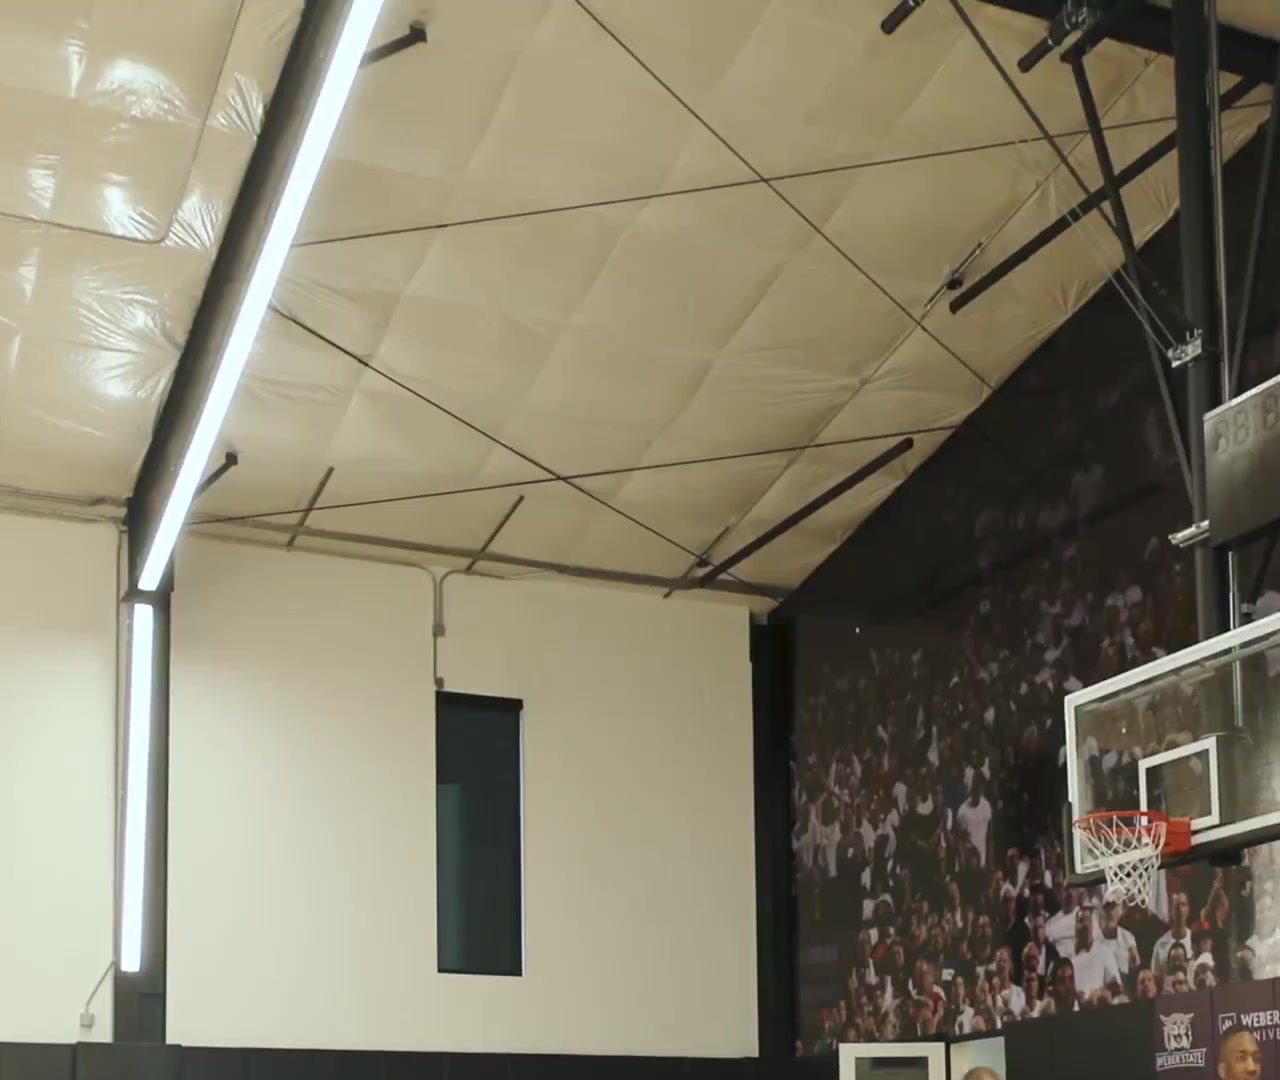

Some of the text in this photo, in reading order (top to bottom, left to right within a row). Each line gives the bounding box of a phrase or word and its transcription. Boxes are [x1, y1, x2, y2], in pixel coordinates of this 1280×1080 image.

[1240, 1009, 1280, 1028] WEBER
[1157, 1052, 1203, 1067] WEBER STATE
